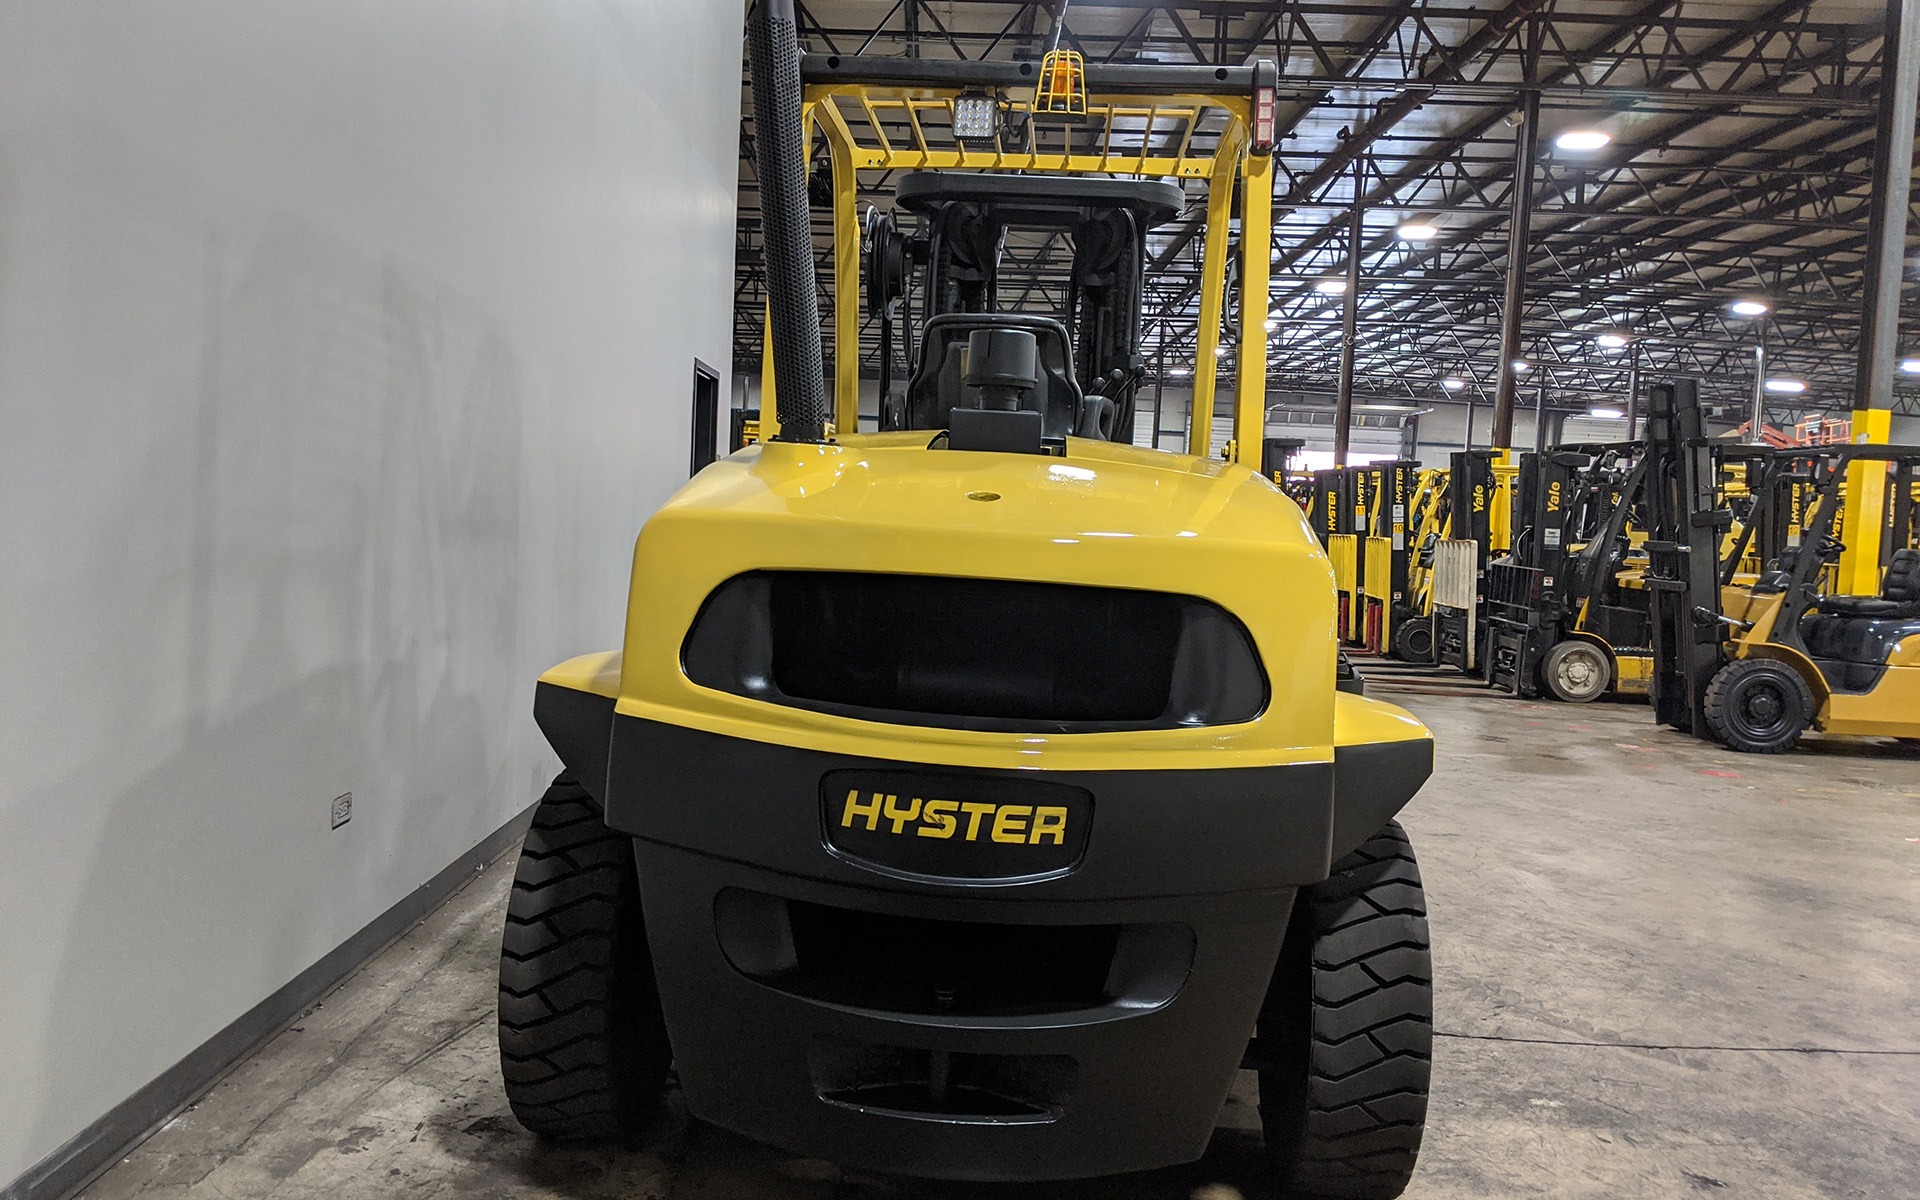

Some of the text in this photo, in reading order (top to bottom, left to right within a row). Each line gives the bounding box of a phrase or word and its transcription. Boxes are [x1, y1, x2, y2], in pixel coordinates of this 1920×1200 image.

[1274, 470, 1282, 488] TER
[1357, 472, 1365, 505] HYSTER
[1395, 467, 1404, 503] HYSTER
[1328, 491, 1336, 531] HYSTER
[1472, 484, 1484, 513] Yale
[1546, 481, 1561, 512] Yale
[1791, 483, 1800, 523] HYSTER
[1789, 527, 1799, 535] 12
[1830, 505, 1845, 542] YSTE
[841, 789, 1069, 845] HYSTER
